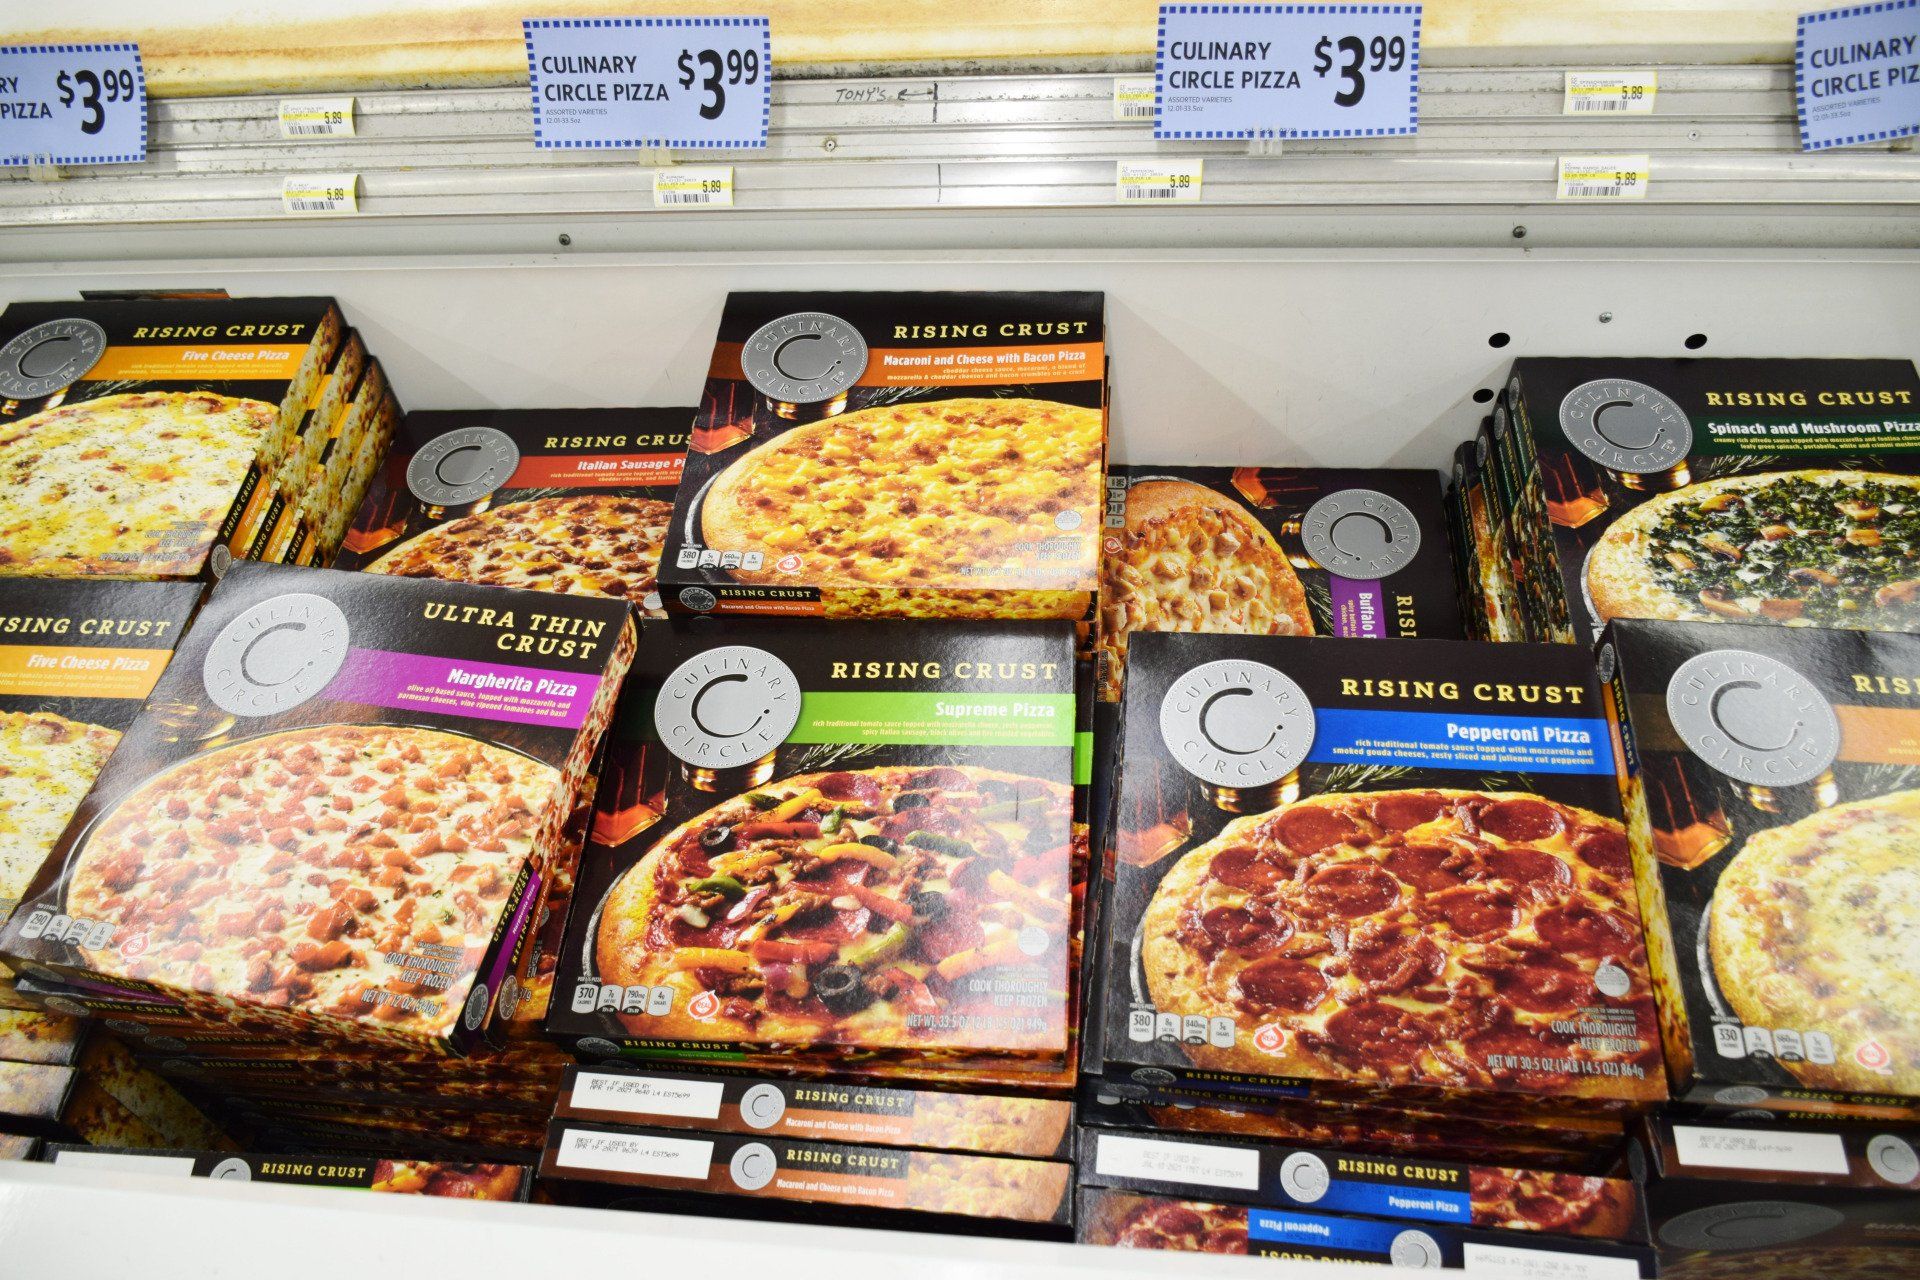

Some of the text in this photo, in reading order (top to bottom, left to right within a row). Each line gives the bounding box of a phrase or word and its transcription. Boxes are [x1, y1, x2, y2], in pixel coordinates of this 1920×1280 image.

[1170, 42, 1271, 60] CULINARY
[1811, 35, 1917, 68] CULINARY
[542, 56, 637, 73] CULINARY
[1169, 71, 1301, 89] CIRCLE PIZZA
[1811, 65, 1920, 97] CIRCLE PIZ
[545, 84, 669, 101] CIRCLE PIZZA
[836, 87, 886, 102] TONY'S
[1622, 86, 1642, 99] 5.89
[0, 103, 52, 119] PIZZA
[1812, 97, 1880, 112] ASSORTED VARIETIES
[324, 111, 342, 124] 5.89
[702, 180, 721, 193] 5.89
[1170, 175, 1190, 188] 5.89
[1615, 172, 1636, 186] 5.89
[326, 187, 344, 201] 5.89
[133, 324, 305, 338] RISING CRUST
[756, 321, 857, 357] CULINARY
[894, 322, 1088, 339] RISING CRUST
[8, 325, 95, 356] CULINARY
[181, 351, 290, 361] Five Cheese Pizza
[883, 351, 1086, 366] Macaroni and Cheese with Bacon Pizza
[756, 369, 846, 397] CIRCLE
[1571, 387, 1678, 425] CULINARY
[1705, 391, 1911, 406] RISING CRUST
[1707, 422, 1881, 436] Spinach and Mushroom
[422, 433, 510, 464] CULINARY
[544, 434, 692, 448] RISING CRUS
[1583, 438, 1677, 466] CIRCLE
[578, 461, 617, 470] Italian
[621, 459, 670, 470] Sausage
[418, 476, 496, 499] CIRCLE
[1311, 501, 1341, 566] CIRCLE
[1361, 497, 1411, 572] CULINARY
[681, 551, 696, 559] 380
[424, 603, 606, 637] ULTRA THIN
[1359, 593, 1375, 630] Buffalo
[1396, 596, 1417, 637] RISI
[0, 617, 171, 637] ISING CRUST
[231, 604, 337, 655] CULINARY
[496, 633, 597, 659] CRUST
[27, 654, 151, 672] Five Cheese Pizza
[831, 662, 1058, 680] RISING CRUST
[216, 667, 308, 707] CIRCLE
[447, 669, 578, 697] Margherita Pizza
[672, 658, 788, 705] CULINARY
[1681, 661, 1818, 715] CULINARY
[1851, 674, 1920, 694] RIS
[436, 687, 455, 696] based
[456, 690, 476, 699] sauce,
[478, 692, 502, 703] topped
[503, 696, 519, 704] with
[520, 697, 556, 707] mozzarella
[557, 701, 570, 709] and
[1176, 672, 1301, 719] CULINARY
[1341, 679, 1583, 704] RISING CRUST
[397, 692, 429, 701] parmesan
[431, 696, 458, 706] cheeses,
[477, 701, 502, 710] ripened
[503, 704, 534, 714] tomatoes
[536, 708, 549, 716] and
[550, 709, 568, 717] basil
[935, 702, 1055, 719] Supreme Pizza
[672, 724, 775, 758] CIRCLE
[1447, 723, 1591, 744] Pepperoni Pizza
[1182, 739, 1293, 777] CIRCLE
[1698, 734, 1818, 773] CIRCLE
[30, 914, 48, 926] 290
[384, 952, 460, 974] COOK THOROUGHLY
[400, 970, 453, 990] KEEP FROZEN
[970, 980, 1048, 994] COOK THOROUGHLY
[578, 988, 594, 998] 370
[994, 994, 1048, 1007] KEEP FROZEN
[1133, 1014, 1150, 1026] 380
[1551, 1021, 1637, 1037] COOK THOROUGHLY
[1719, 1029, 1738, 1041] 330
[1604, 1039, 1641, 1052] FROZEN
[1487, 1054, 1503, 1068] NET
[1505, 1056, 1518, 1069] WT
[1520, 1057, 1540, 1070] 30.5
[1542, 1058, 1557, 1072] OZ
[1582, 1061, 1600, 1074] 14.5
[1602, 1061, 1619, 1077] OZ)
[1621, 1064, 1645, 1080] 864g
[795, 1089, 905, 1107] RISING CRUST
[786, 1118, 814, 1127] Macaroni
[827, 1121, 848, 1131] Cheese
[786, 1149, 899, 1169] RISING CRUST
[261, 1161, 367, 1179] RISING CRUST
[1338, 1159, 1460, 1183] RISING CRUST
[777, 1179, 841, 1193] Macaroni and Cheese
[1389, 1195, 1459, 1213] Pepperoni Pizza
[1260, 1219, 1329, 1236] Pepperoni Pizza
